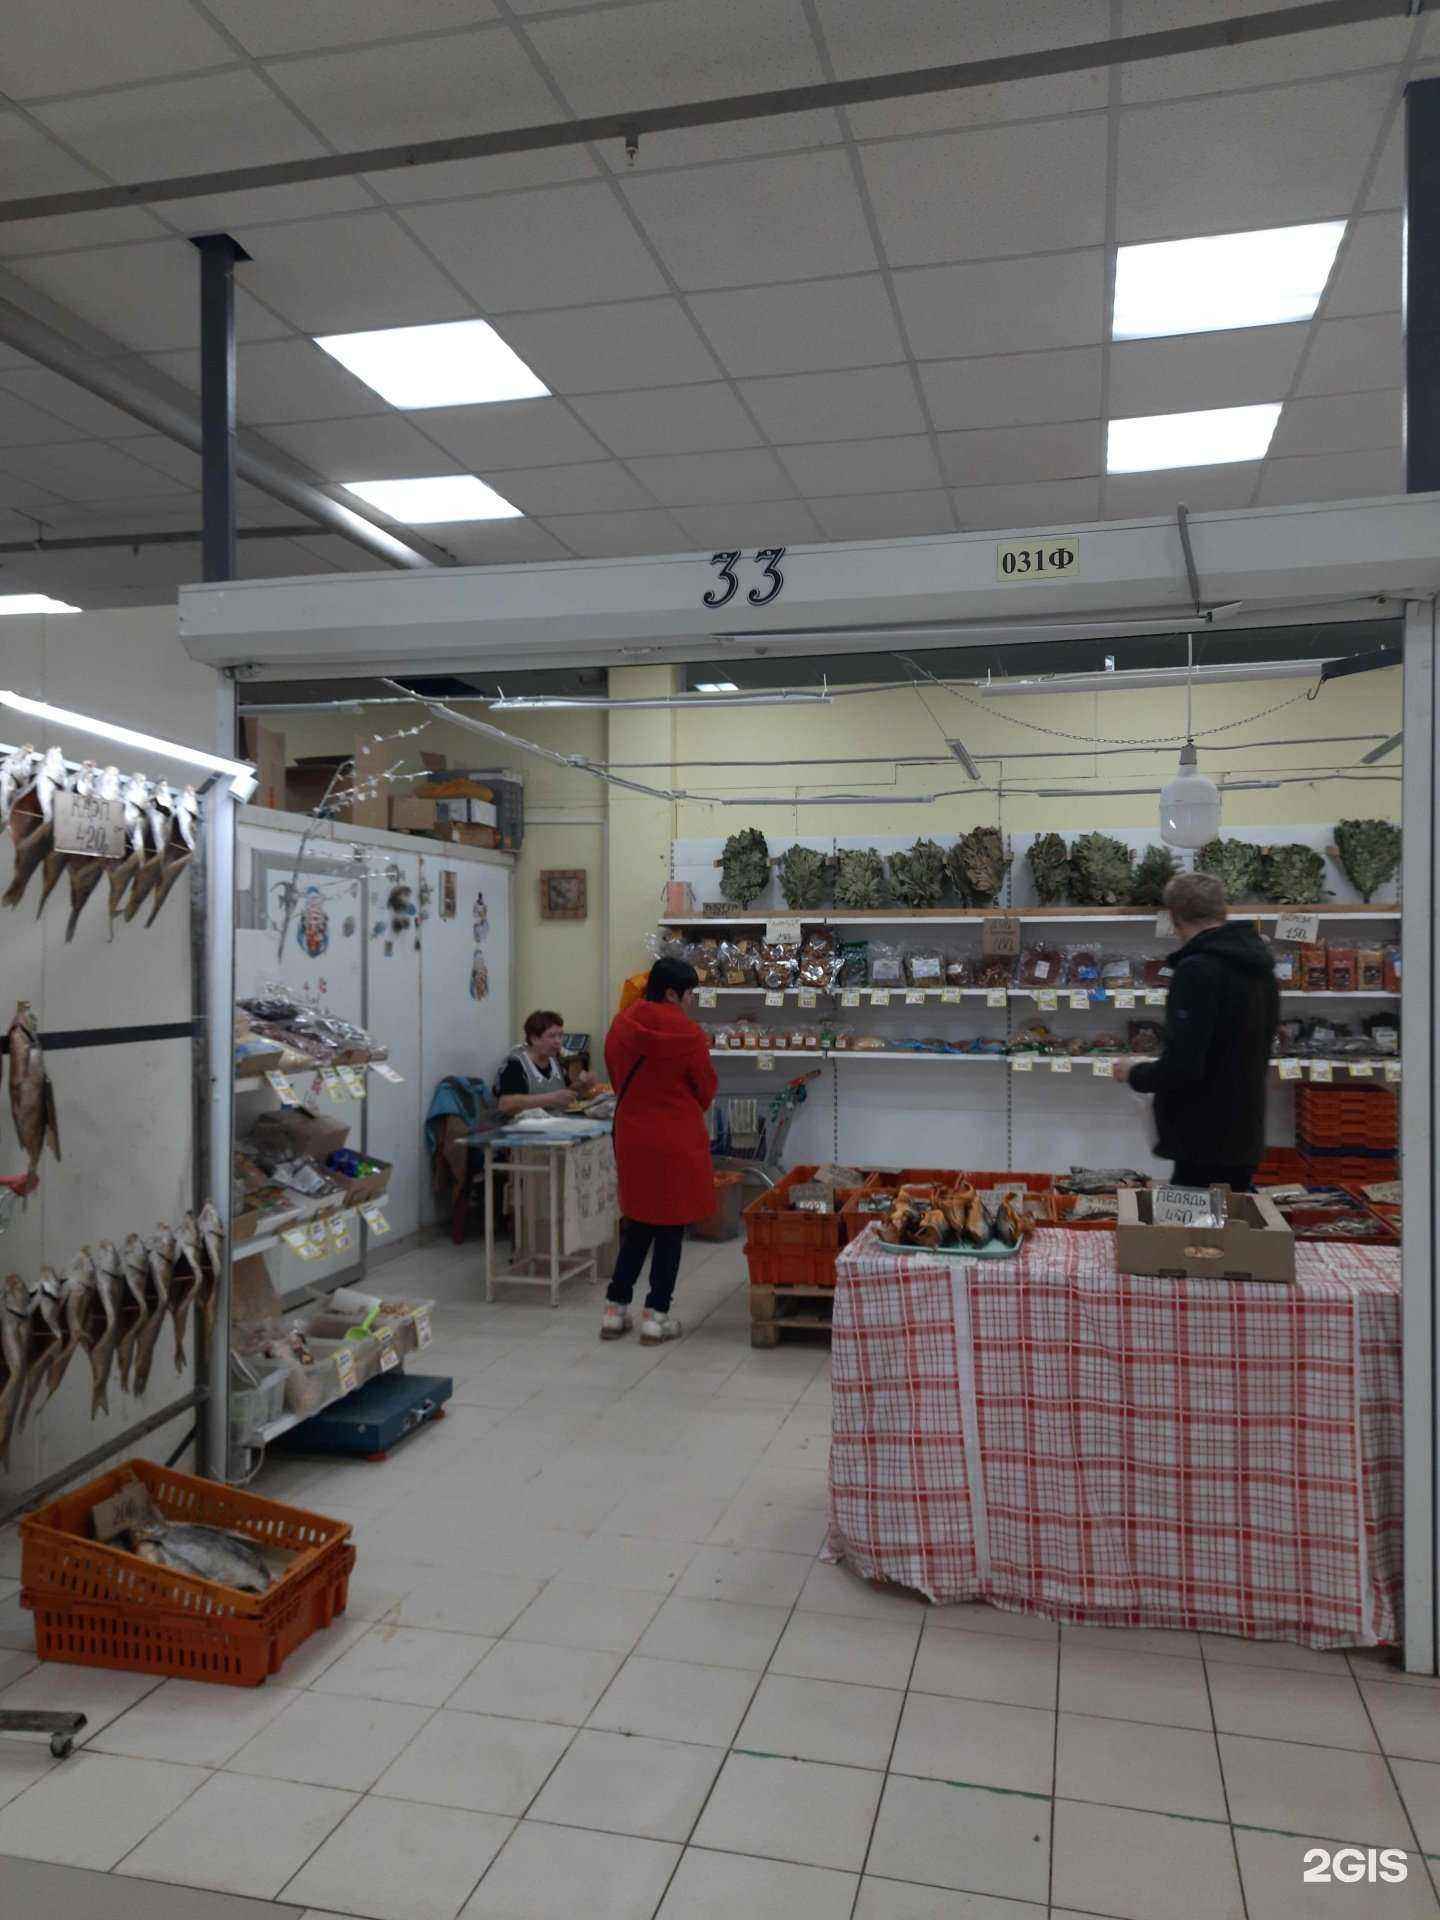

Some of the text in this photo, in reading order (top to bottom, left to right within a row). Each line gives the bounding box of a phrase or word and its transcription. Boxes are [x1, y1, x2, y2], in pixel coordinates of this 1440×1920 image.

[1002, 548, 1074, 574] 031Ф
[703, 548, 785, 608] 33
[1156, 1191, 1206, 1206] ПЕЛЯДЬ
